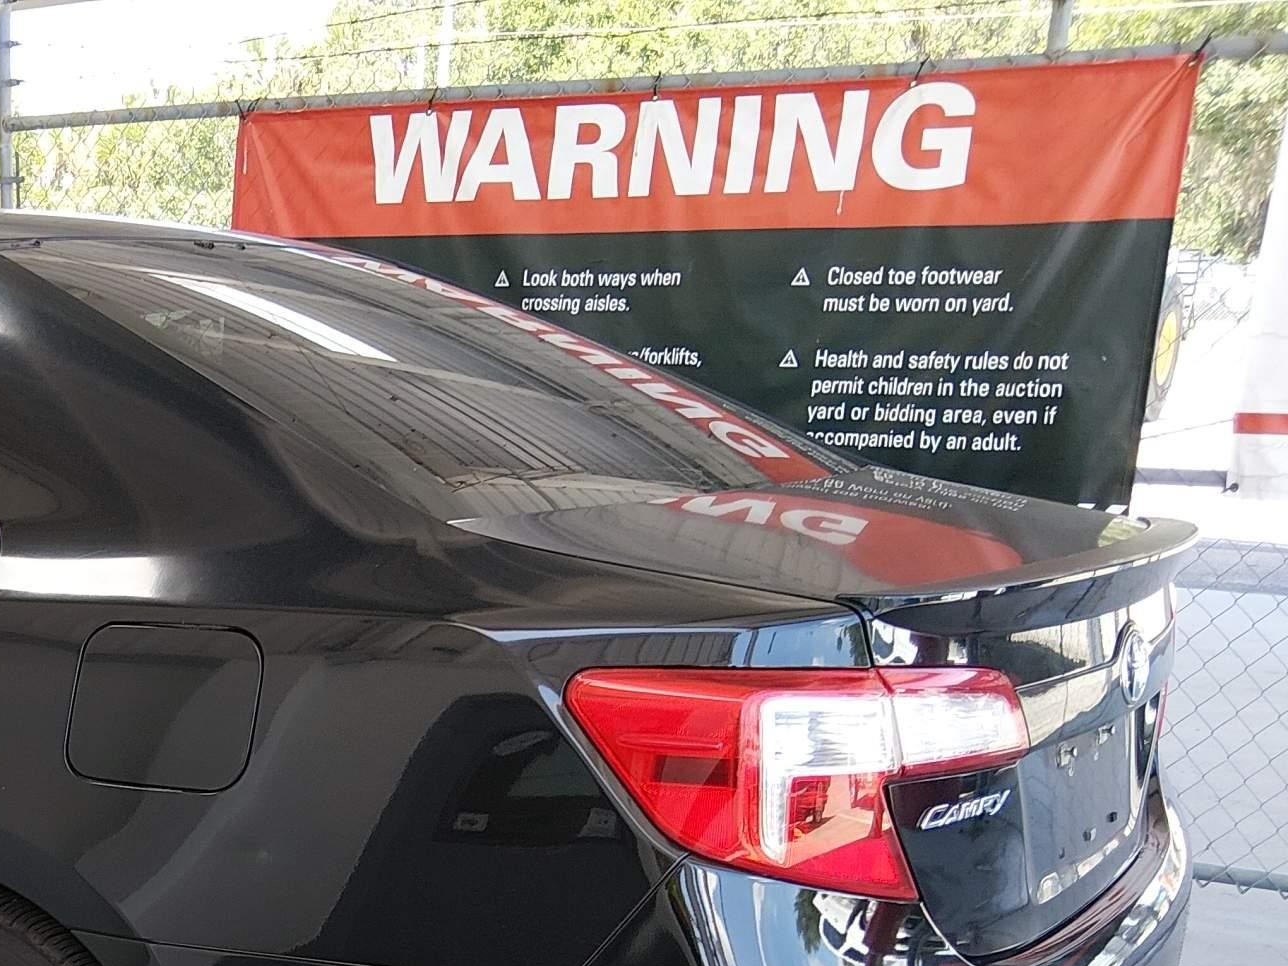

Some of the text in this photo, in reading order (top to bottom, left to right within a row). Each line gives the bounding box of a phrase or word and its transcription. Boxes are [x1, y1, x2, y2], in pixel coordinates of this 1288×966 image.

[369, 81, 977, 206] WARNING
[522, 268, 682, 290] Look both ways when
[827, 265, 1004, 286] Closed toe footwear
[521, 293, 630, 314] crossing aisles.
[822, 292, 1014, 317] must be worn on yard.
[628, 347, 702, 368] /forklifts,
[814, 349, 1070, 374] Health and safety rules do not
[810, 375, 1063, 398] permit children in the auction
[807, 402, 1058, 427] yard or bidding area, even if
[919, 430, 942, 454] by
[945, 435, 967, 450] an
[971, 432, 1022, 451] adult.
[920, 788, 1011, 831] CAMRY
